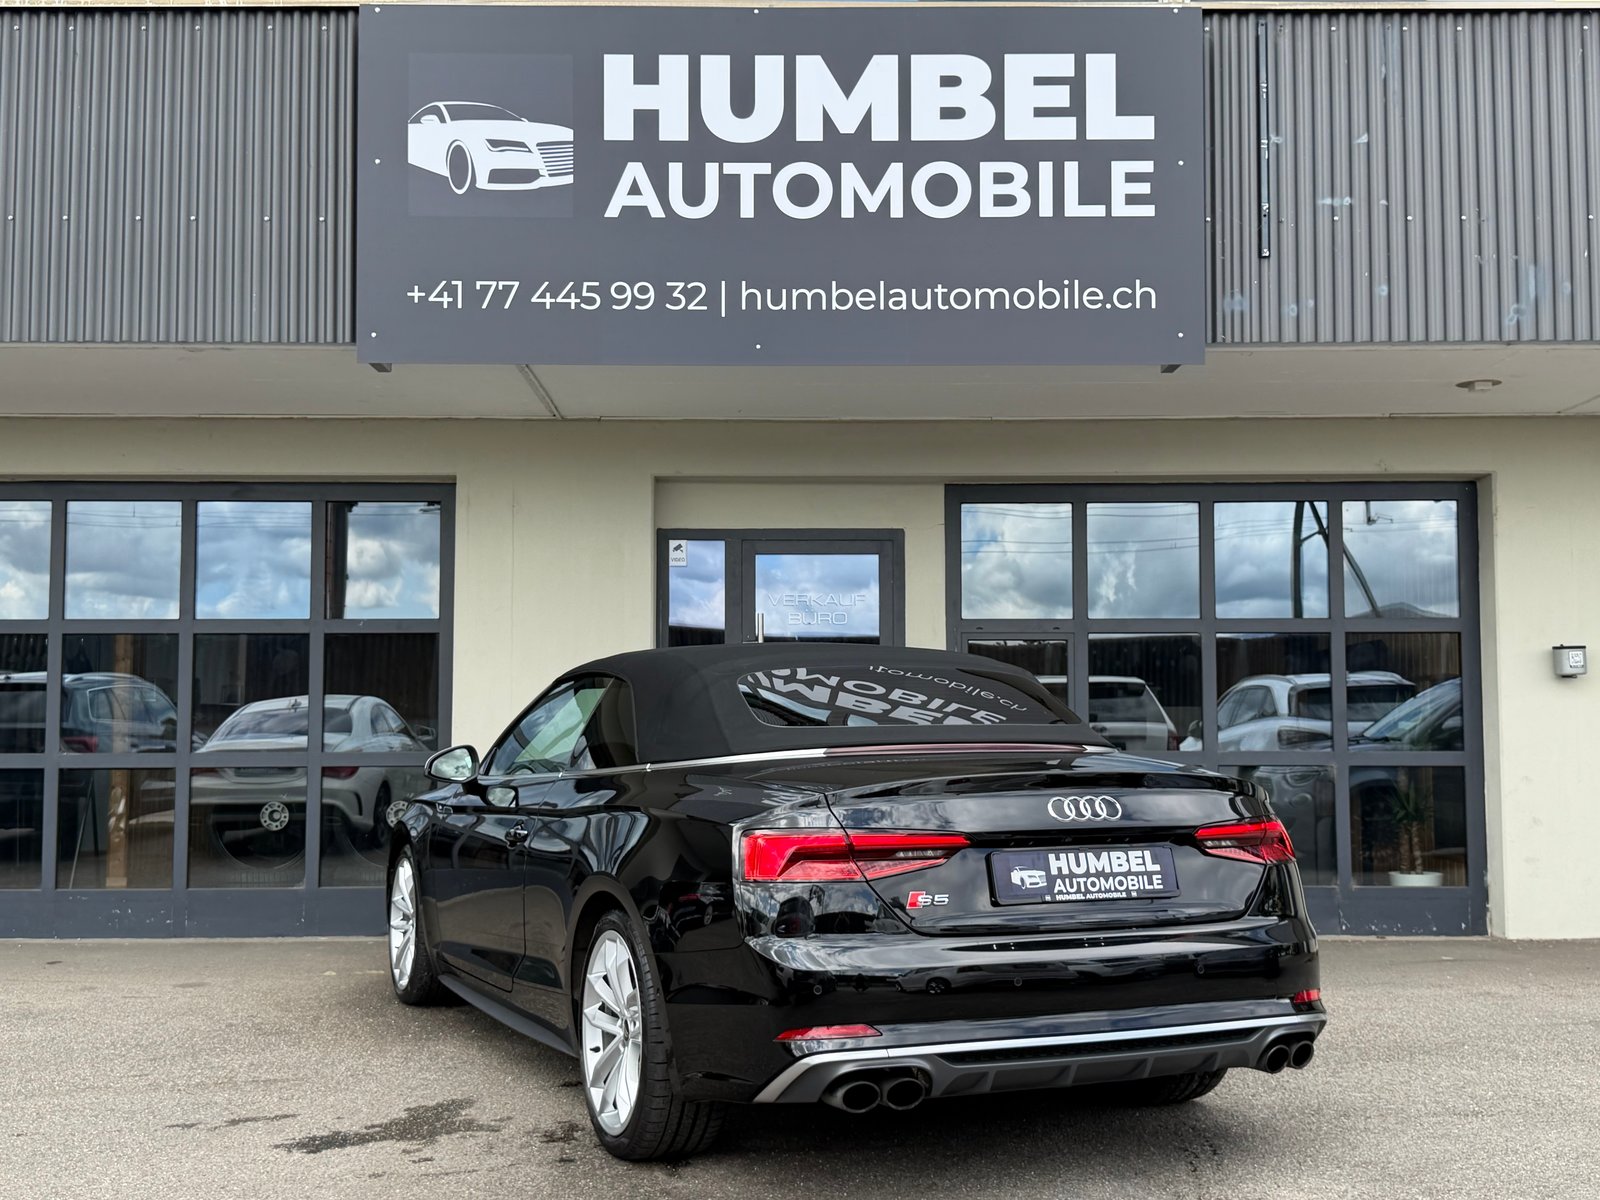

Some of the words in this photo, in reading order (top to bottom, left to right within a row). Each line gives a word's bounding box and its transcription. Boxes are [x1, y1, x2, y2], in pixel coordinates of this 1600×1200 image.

[603, 53, 1155, 144] HUMBEL
[603, 160, 1156, 220] AUTOMOBILE
[406, 280, 463, 309] +41
[475, 280, 520, 310] 77
[530, 281, 601, 311] 445
[610, 281, 655, 311] 99
[665, 281, 708, 311] 32
[741, 279, 1157, 311] humbelautomobile.ch
[768, 592, 866, 607] VERKAUF
[1048, 850, 1161, 876] HUMBEL
[1053, 874, 1164, 894] AUTOMOBILE
[917, 893, 950, 906] S5
[1055, 893, 1086, 901] HUMBEL
[1086, 891, 1127, 900] AUTOMOBILE
